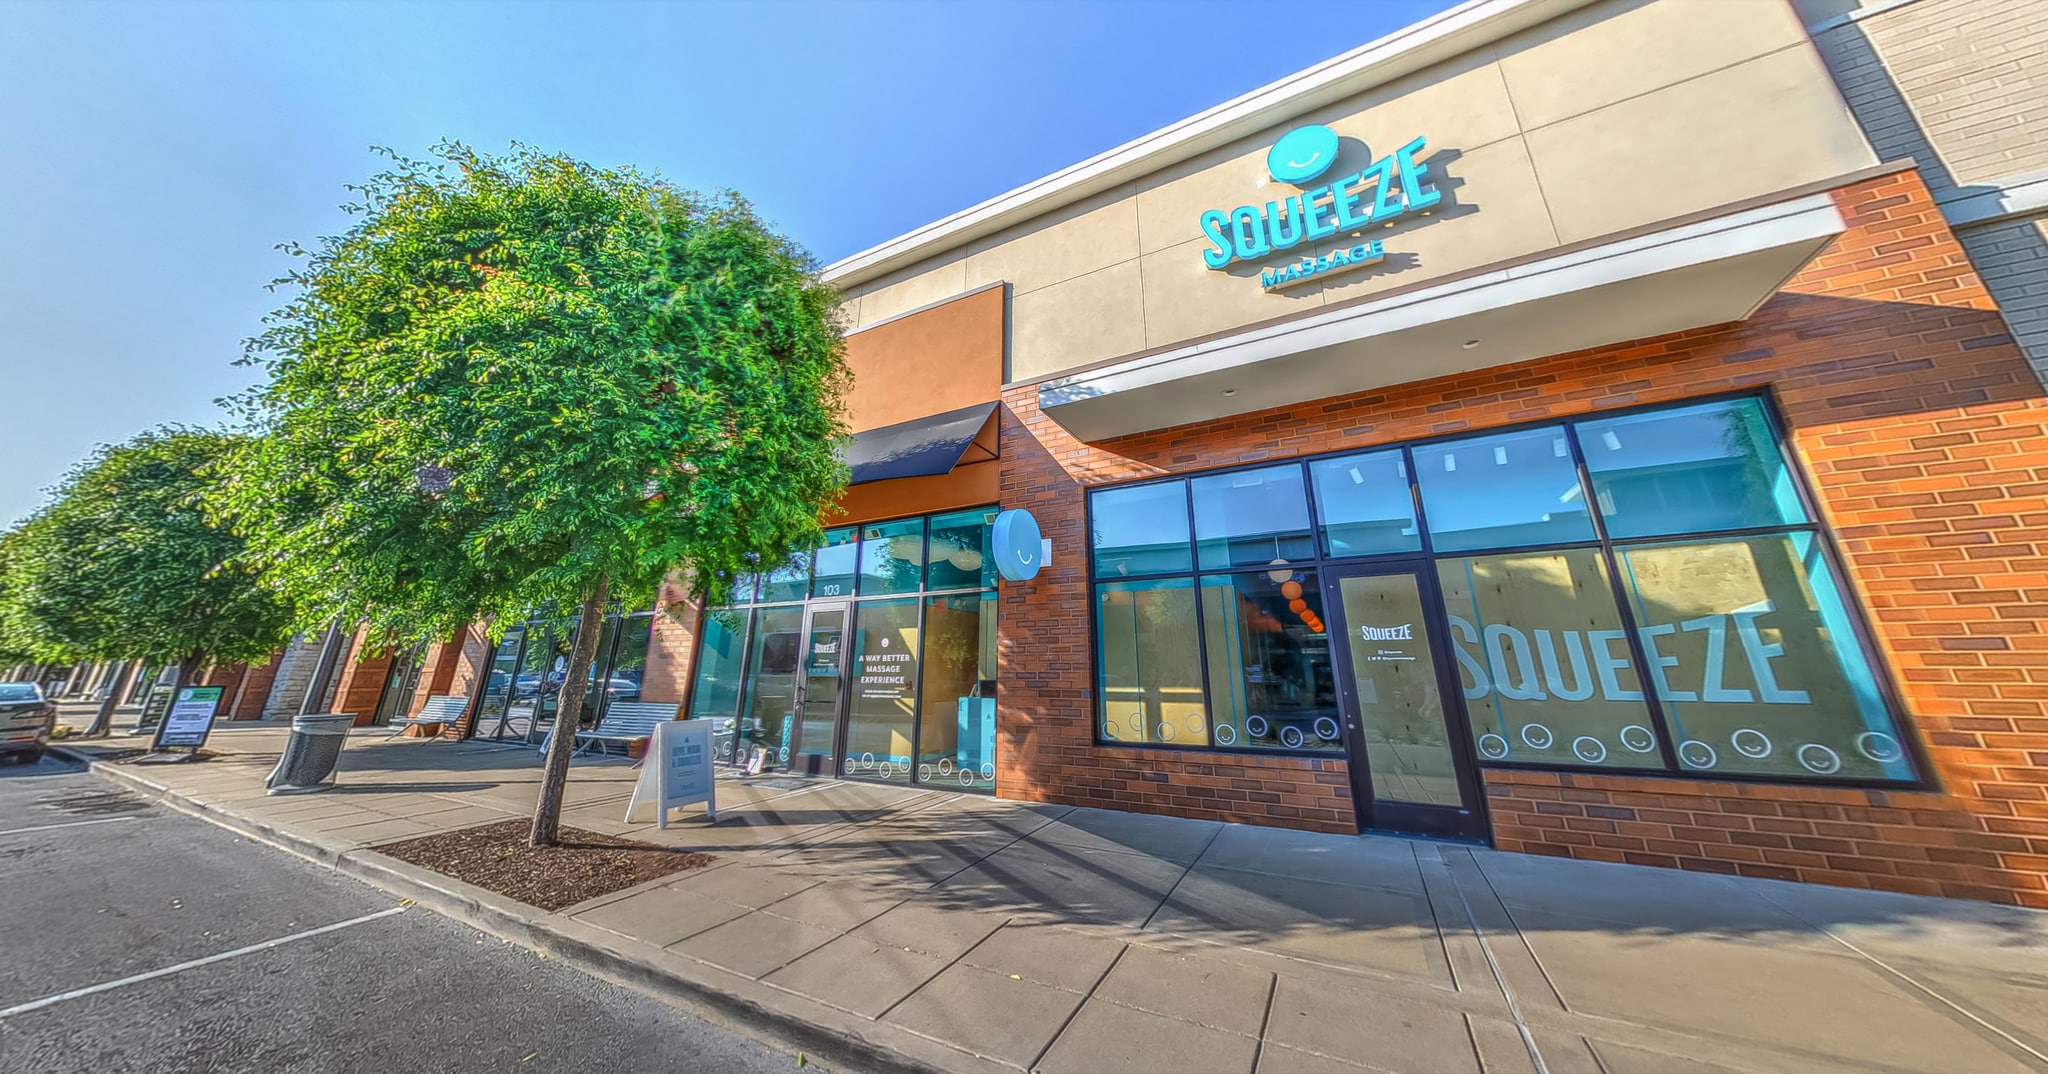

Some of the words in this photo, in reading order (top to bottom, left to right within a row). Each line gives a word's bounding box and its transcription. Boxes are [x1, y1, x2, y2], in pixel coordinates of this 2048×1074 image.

[1200, 135, 1442, 270] SQUEEZE
[1261, 239, 1385, 289] MASSAGE
[823, 584, 840, 596] 103
[1361, 623, 1413, 641] SQUEEZE
[858, 654, 864, 662] A
[865, 654, 881, 662] WAY
[882, 654, 910, 662] BETTER
[1449, 599, 1812, 704] SQUEEZE
[865, 665, 901, 673] MASSAGE
[860, 676, 905, 684] EXPERIENCE
